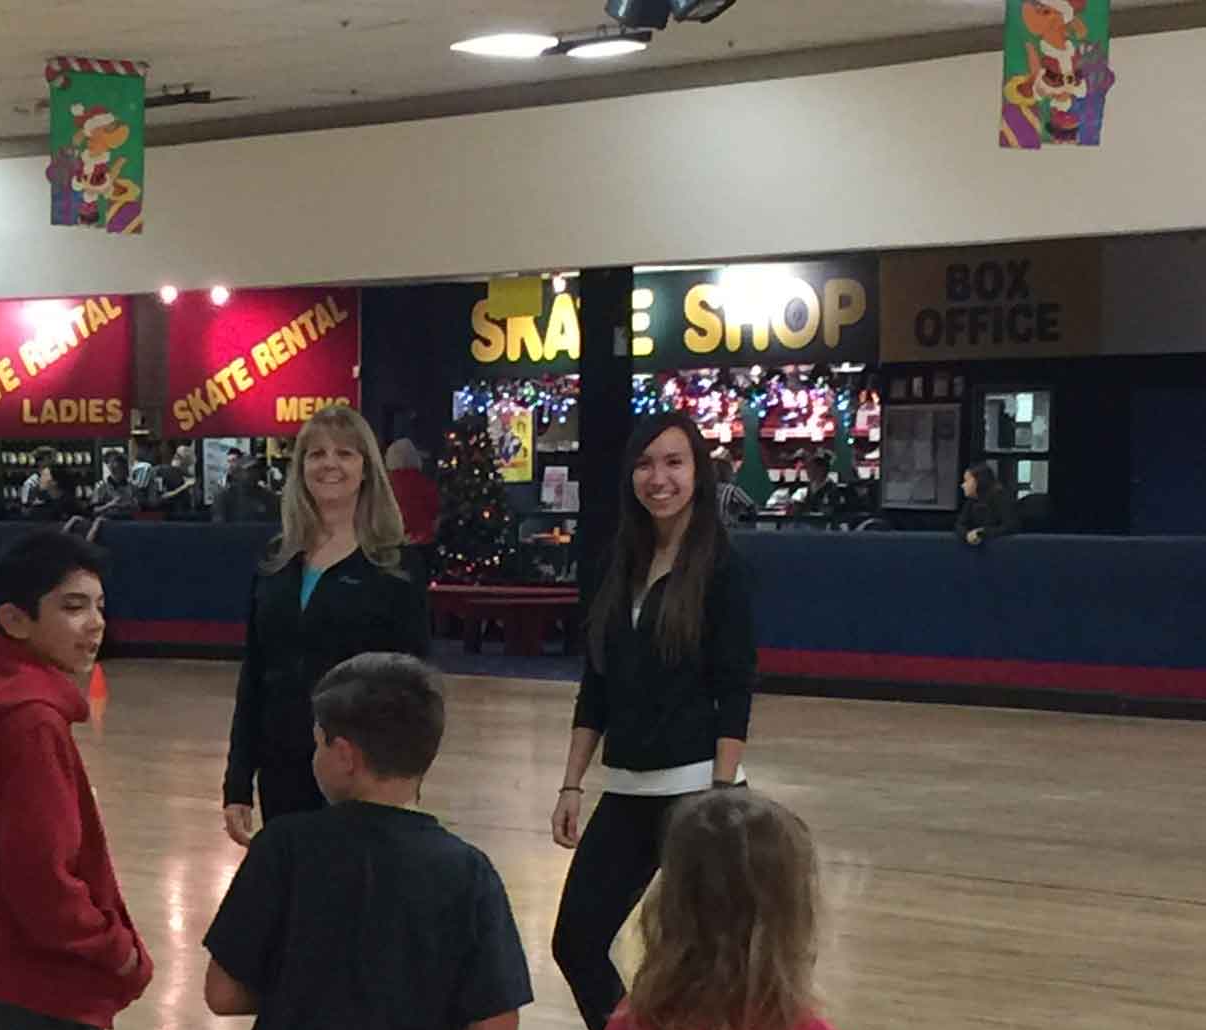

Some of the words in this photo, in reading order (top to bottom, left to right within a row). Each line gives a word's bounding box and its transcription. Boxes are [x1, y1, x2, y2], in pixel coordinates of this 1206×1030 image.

[945, 257, 1032, 302] BOX
[18, 296, 122, 376] RENTAL
[471, 285, 654, 363] SKAE
[683, 278, 867, 353] SHOP
[913, 302, 1064, 348] OFFICE
[173, 357, 254, 432] SKATE
[251, 296, 348, 376] RENTAL
[22, 398, 123, 424] LADIES
